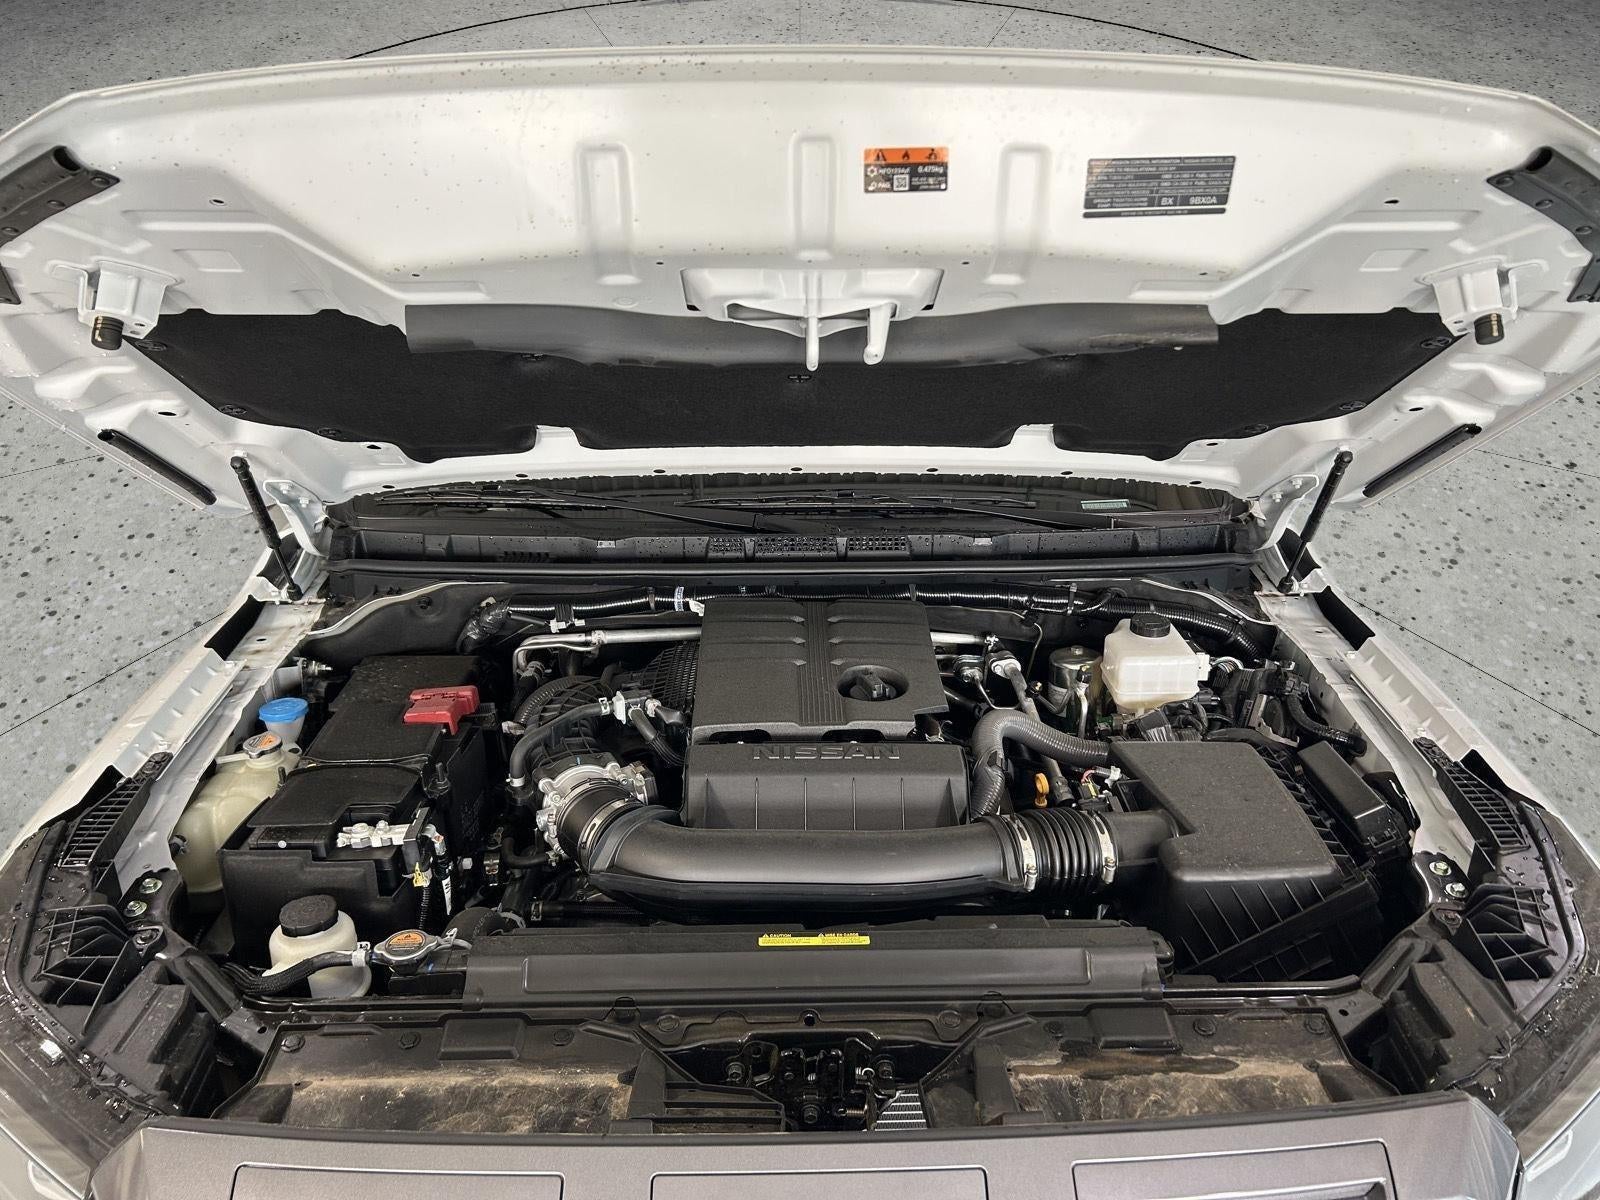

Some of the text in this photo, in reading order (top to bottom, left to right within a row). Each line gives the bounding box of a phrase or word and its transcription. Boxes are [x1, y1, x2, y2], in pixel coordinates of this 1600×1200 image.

[917, 165, 944, 173] 0.475kg
[1160, 197, 1175, 206] BX
[753, 744, 900, 760] NISSAN
